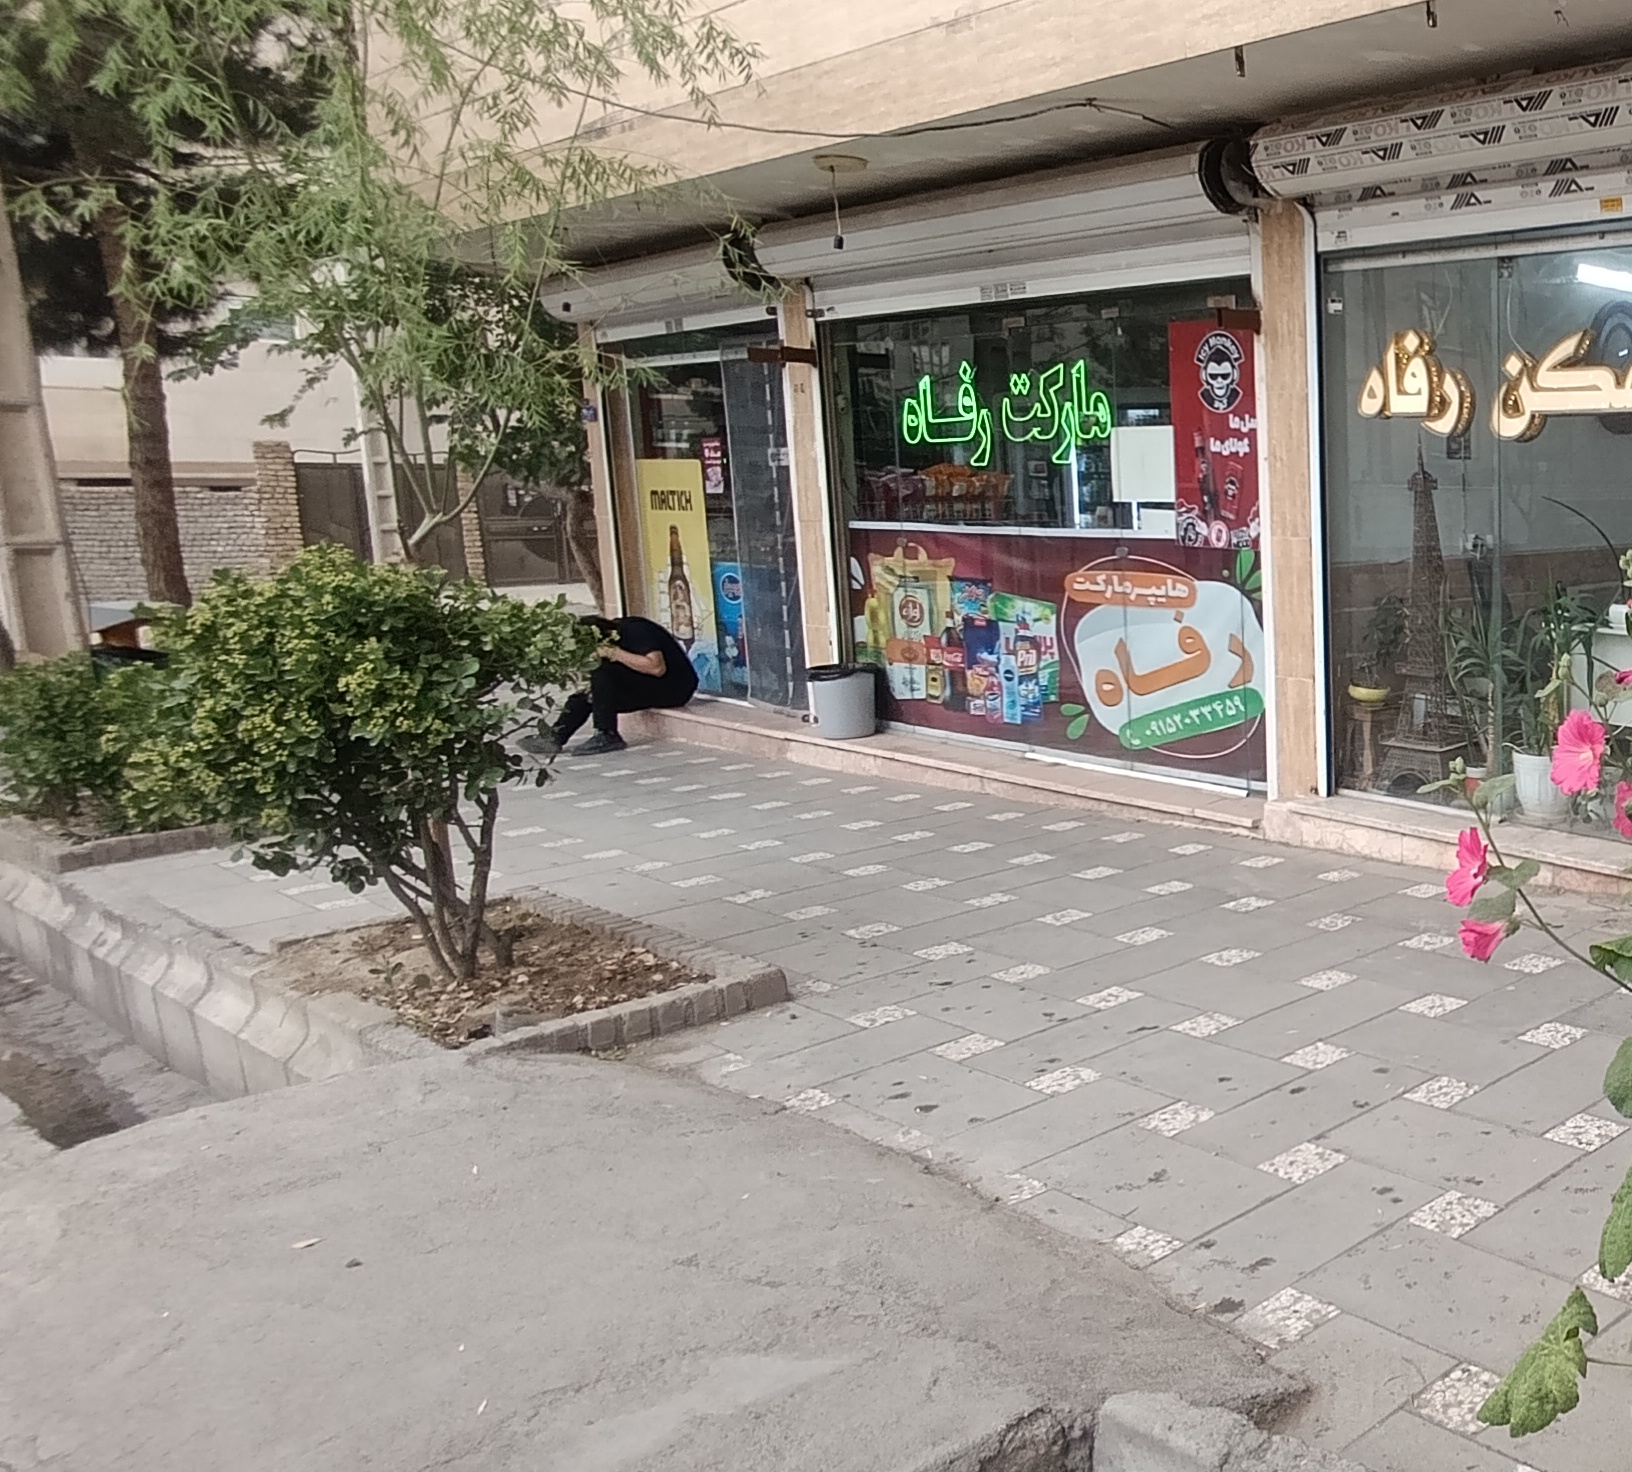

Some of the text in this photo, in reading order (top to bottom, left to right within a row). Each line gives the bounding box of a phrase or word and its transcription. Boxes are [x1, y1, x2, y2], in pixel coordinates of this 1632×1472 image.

[1198, 336, 1240, 360] Icy Monkey
[903, 359, 1112, 467] مارکت رفاه
[1357, 328, 1473, 438] رفاه
[1073, 574, 1189, 605] هایپرمارکت
[1095, 610, 1254, 707] رفاه
[1145, 695, 1246, 737] ۰۹۱۵۲۰۳۳۴۵۹
